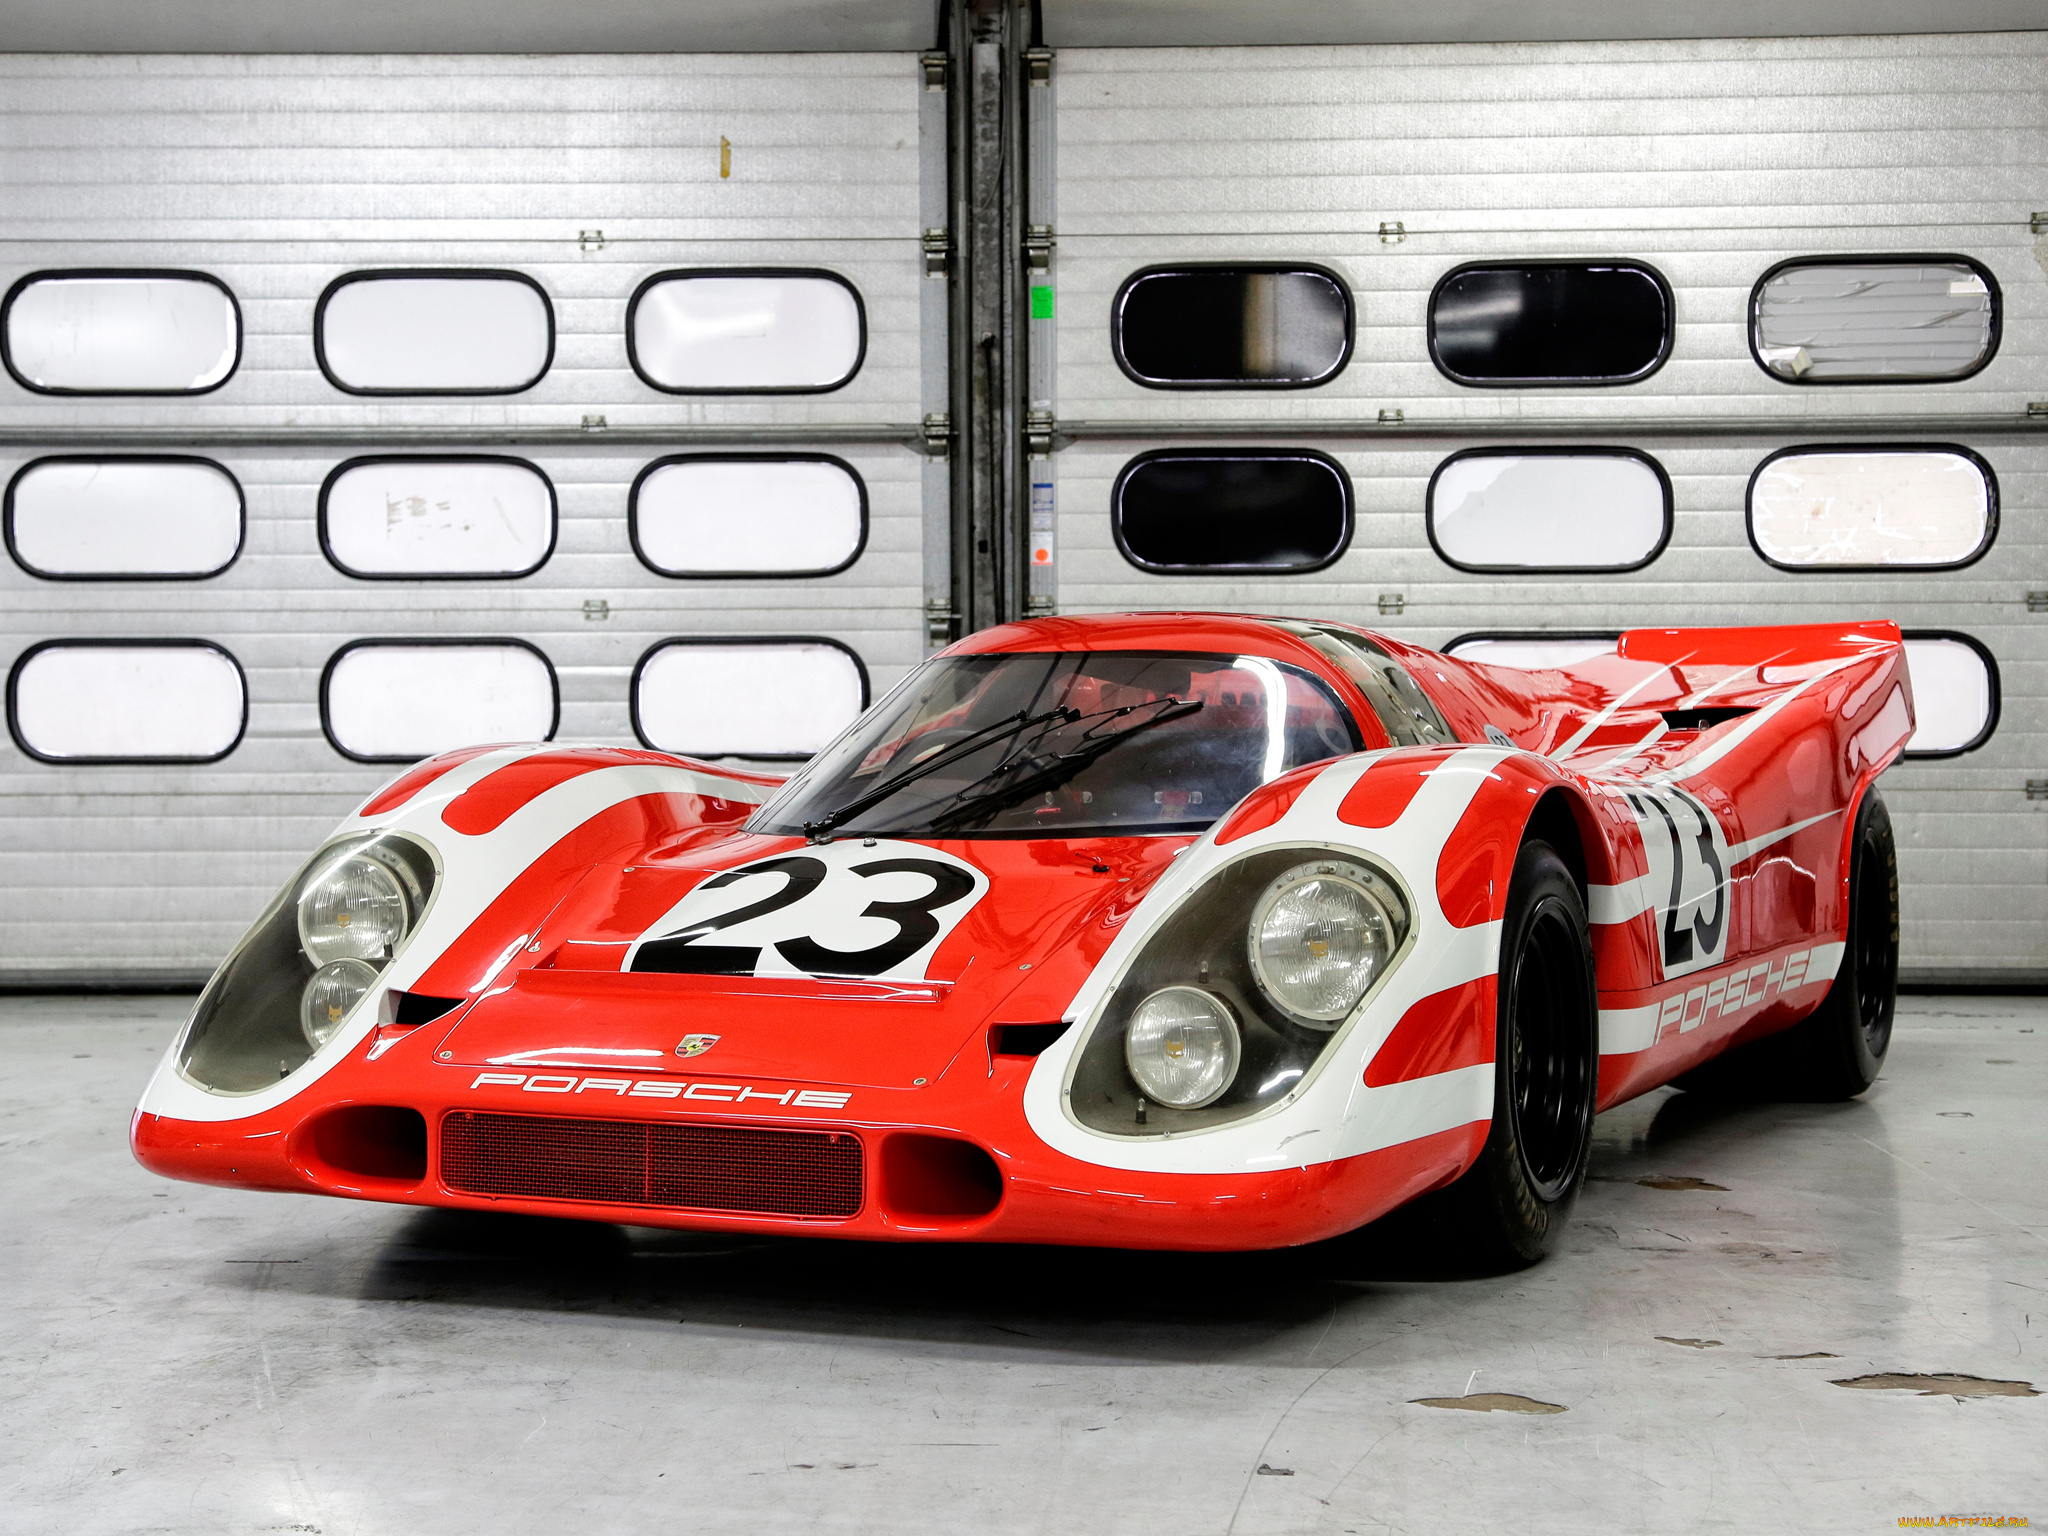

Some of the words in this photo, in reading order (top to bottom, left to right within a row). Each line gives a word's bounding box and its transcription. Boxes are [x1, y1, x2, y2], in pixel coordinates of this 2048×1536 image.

[630, 856, 975, 980] 23
[1627, 787, 1725, 967] 23
[1655, 949, 1812, 1045] PORSCHE
[470, 1073, 853, 1108] PORSCHE
